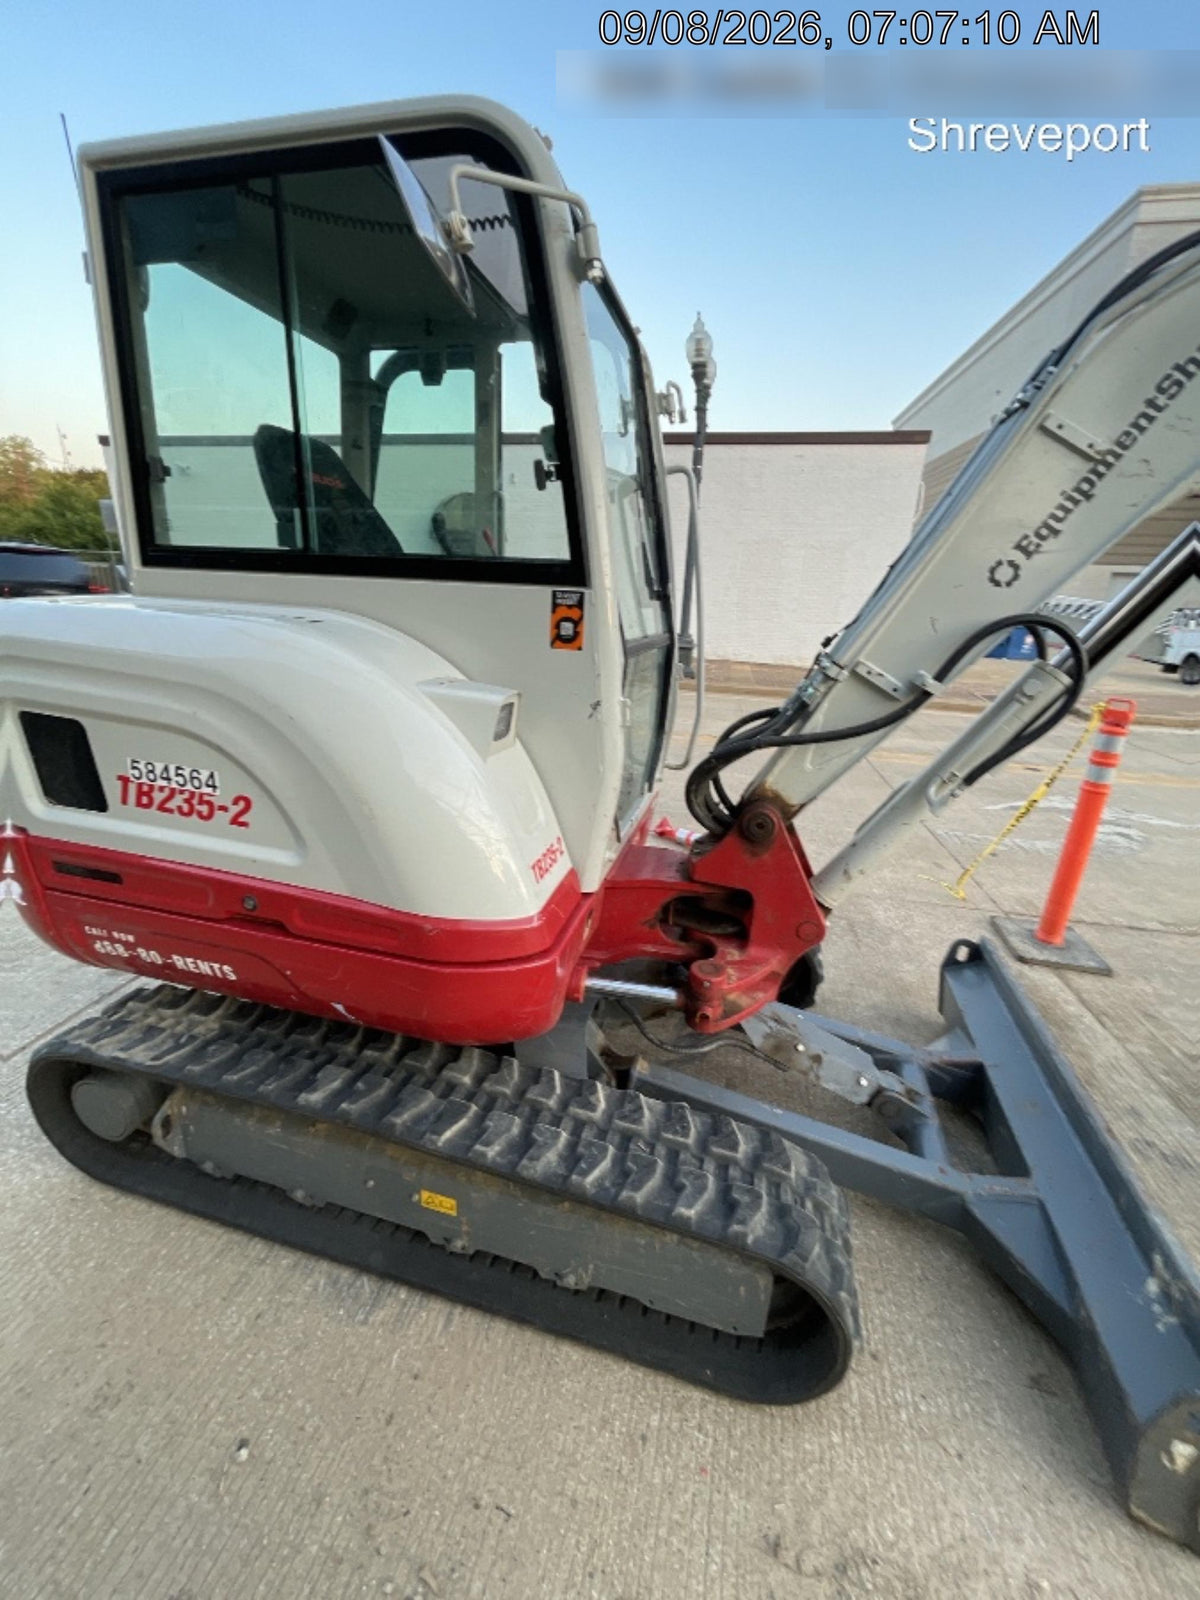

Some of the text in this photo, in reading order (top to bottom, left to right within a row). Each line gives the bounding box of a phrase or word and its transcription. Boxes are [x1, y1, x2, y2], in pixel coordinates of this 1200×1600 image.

[1012, 343, 1200, 560] EquipmentSh
[116, 774, 253, 828] TB235-2
[130, 758, 218, 793] 584564
